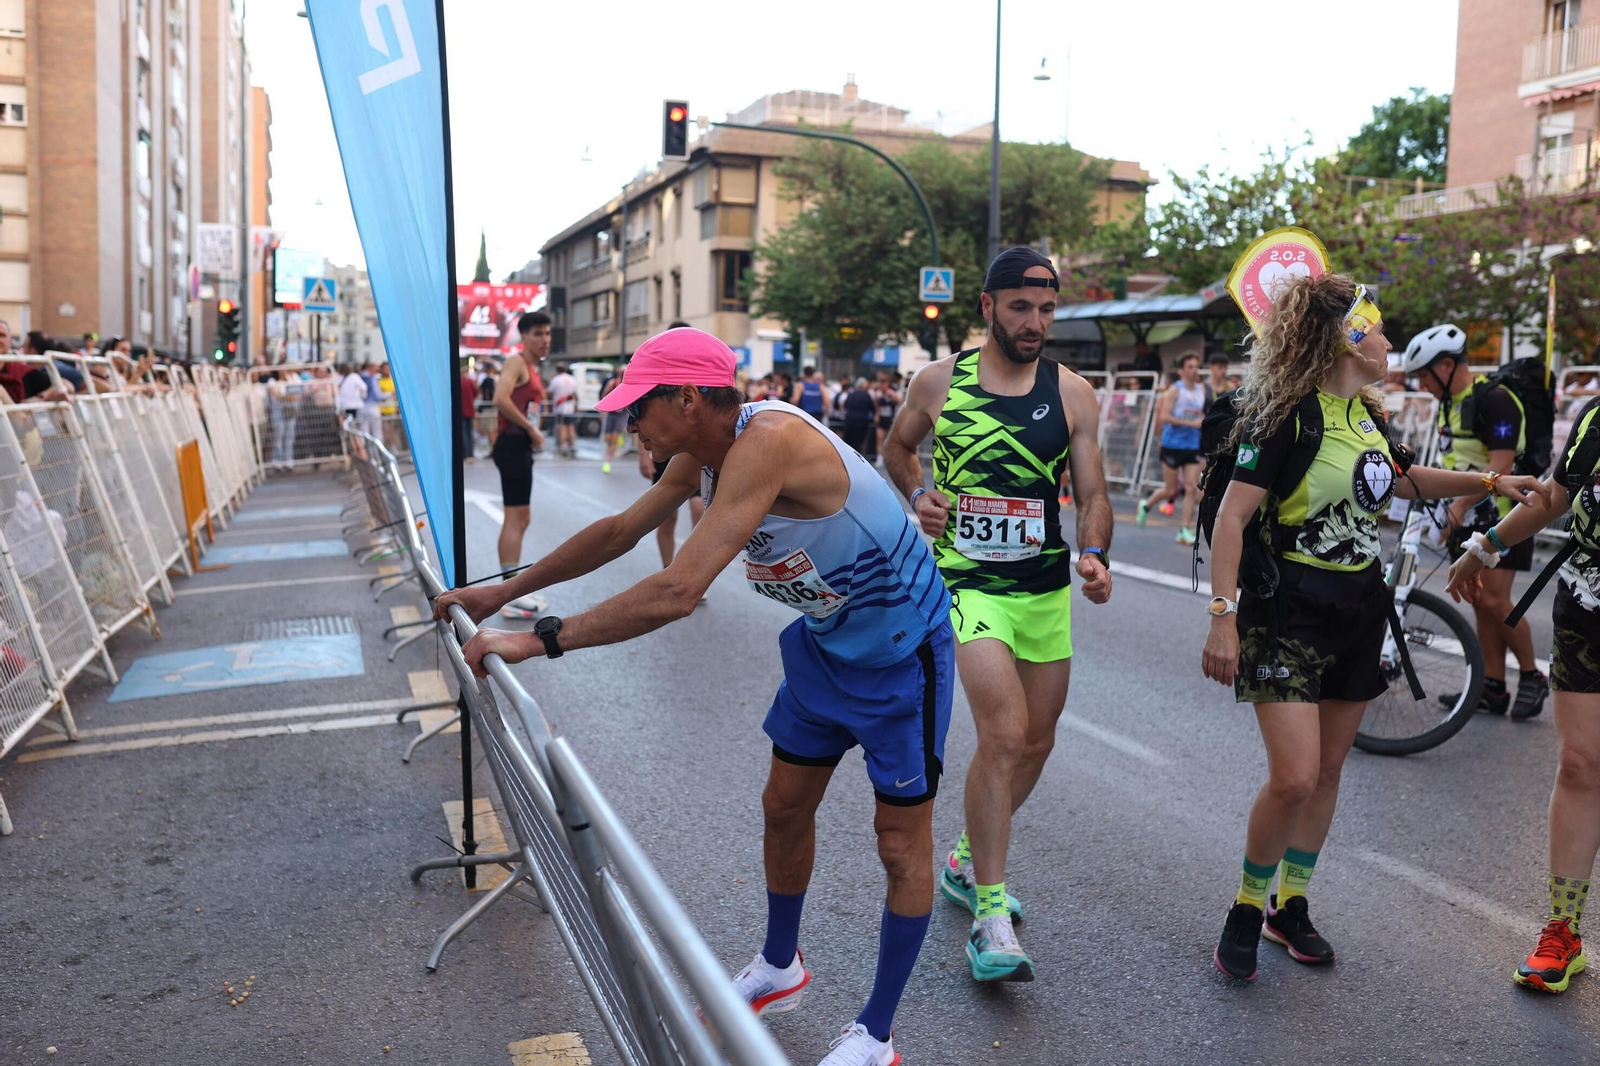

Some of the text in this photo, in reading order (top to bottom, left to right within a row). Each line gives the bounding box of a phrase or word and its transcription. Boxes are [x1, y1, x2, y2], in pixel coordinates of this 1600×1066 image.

[961, 497, 973, 512] 41
[973, 499, 986, 507] MEDIA
[1356, 480, 1370, 507] CARDIO
[1582, 490, 1593, 513] CARD
[959, 515, 1026, 544] 5311
[745, 531, 775, 553] ENA
